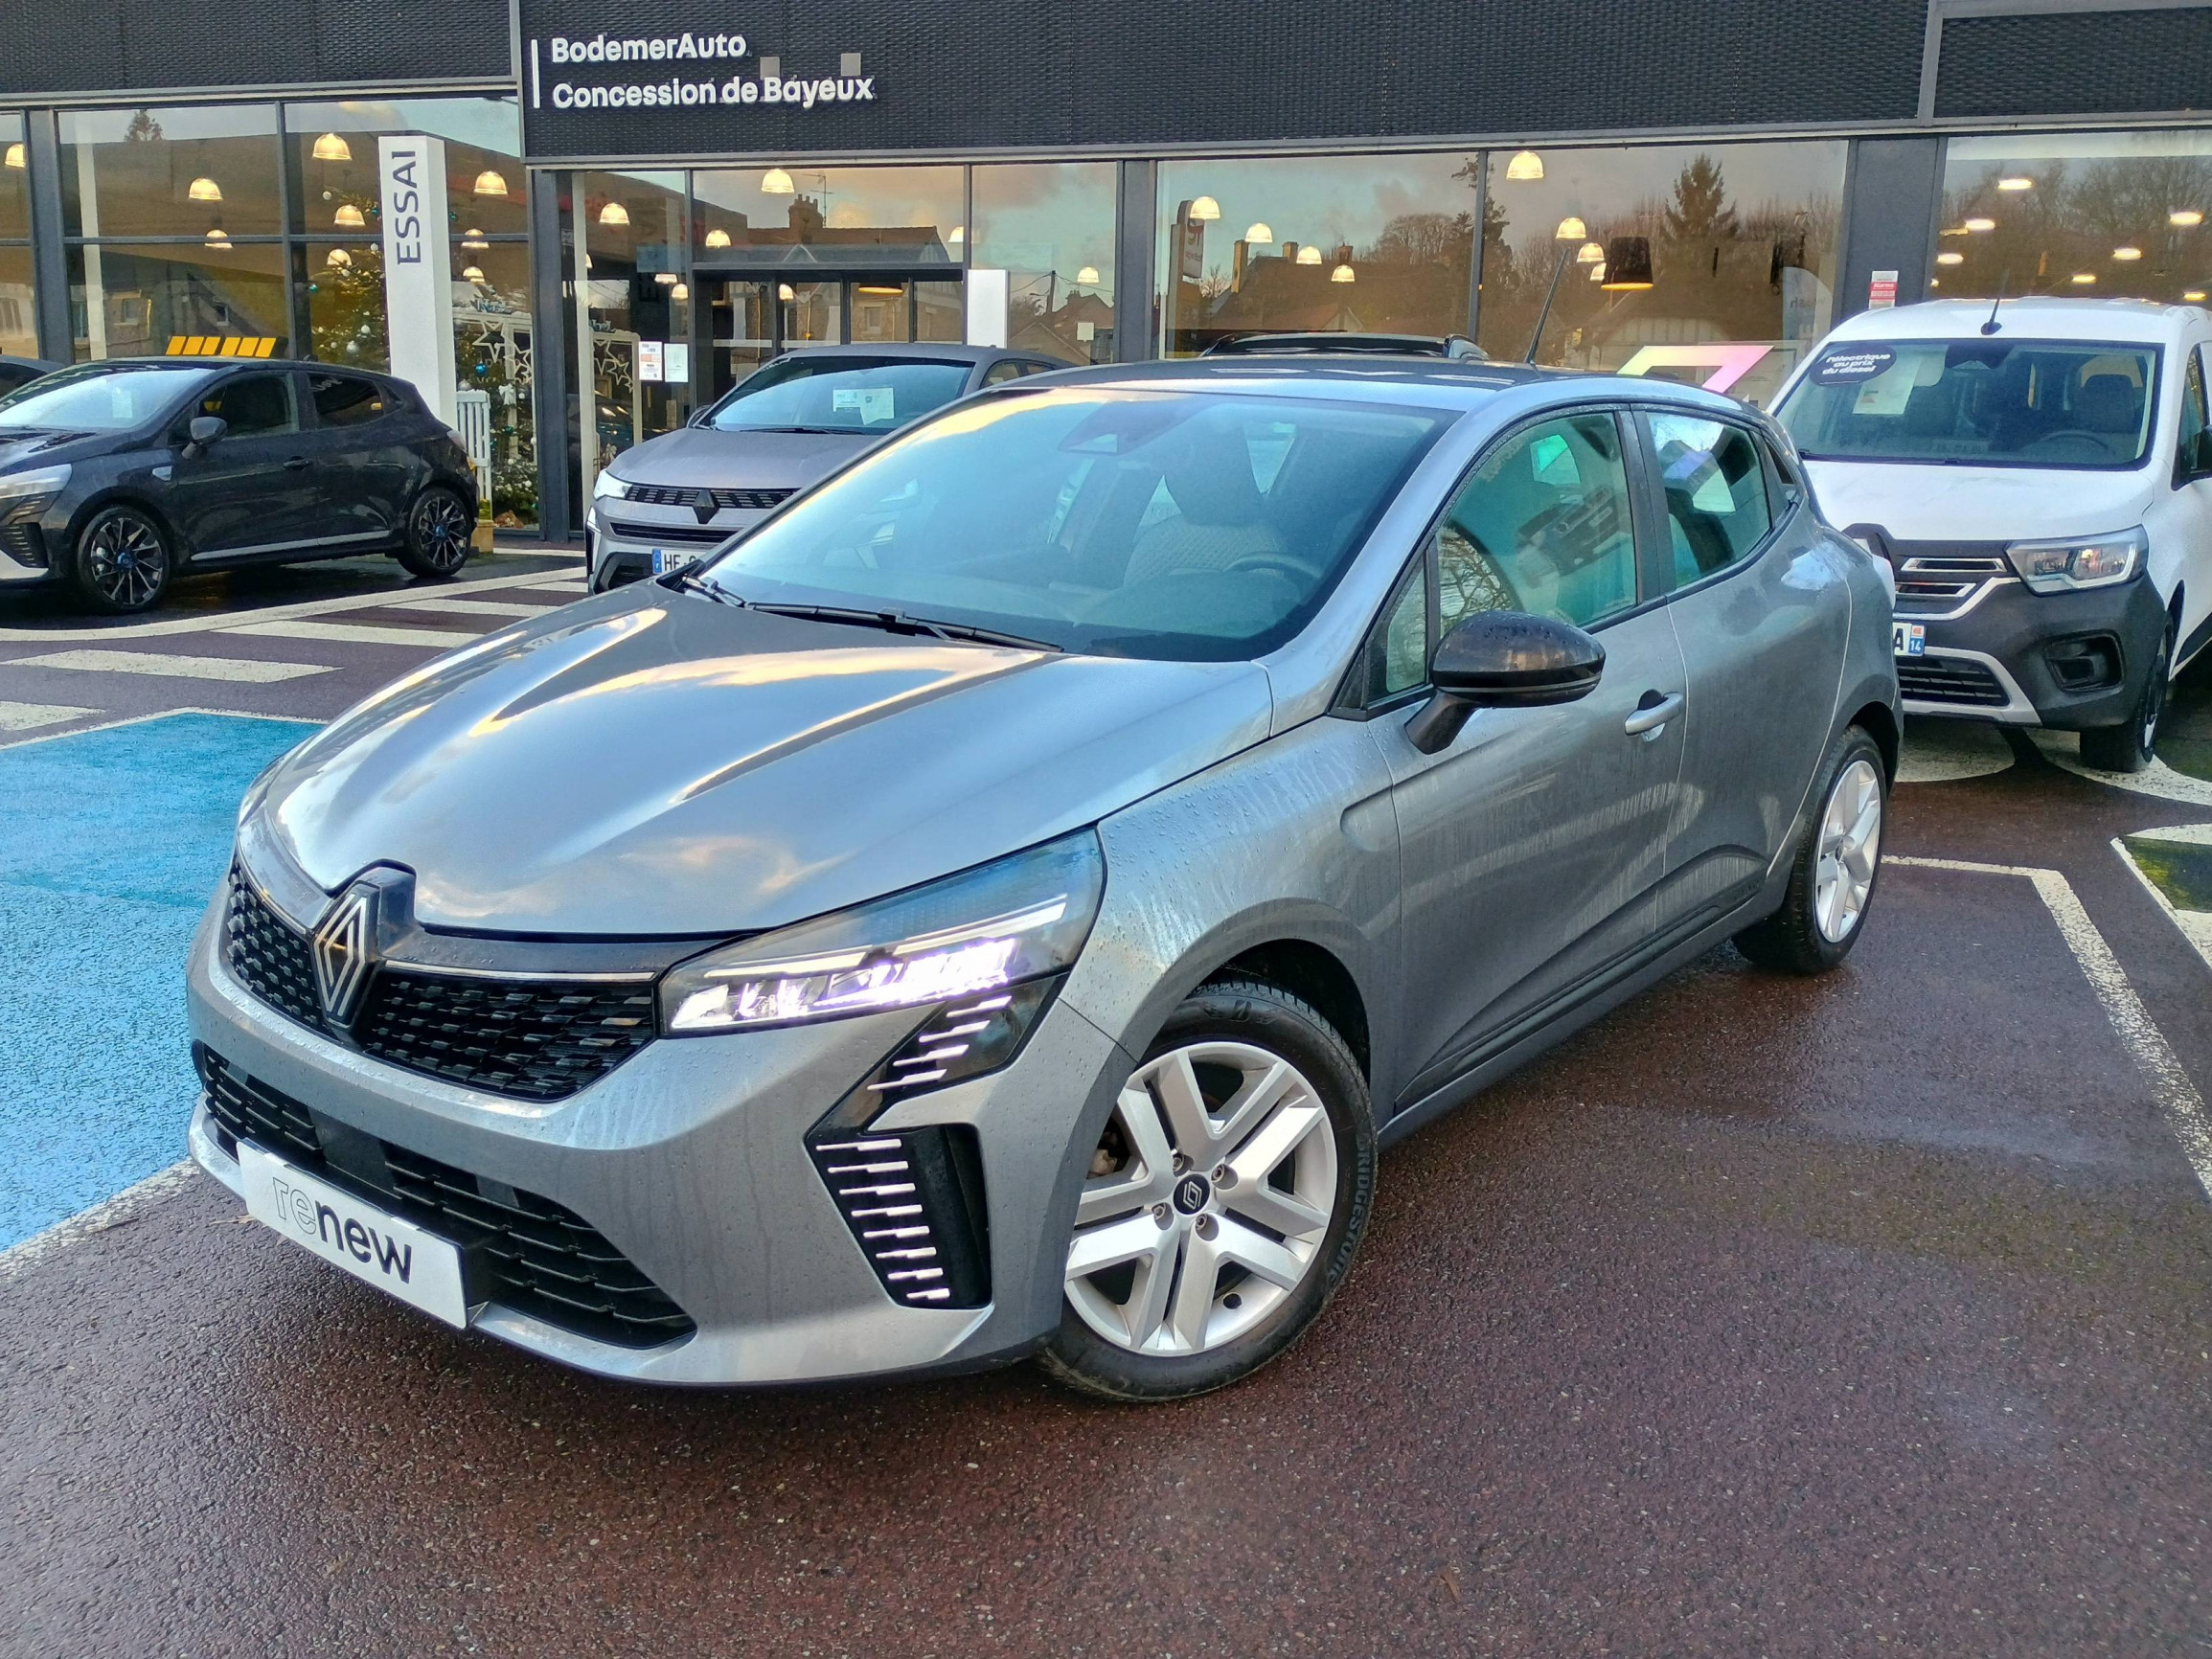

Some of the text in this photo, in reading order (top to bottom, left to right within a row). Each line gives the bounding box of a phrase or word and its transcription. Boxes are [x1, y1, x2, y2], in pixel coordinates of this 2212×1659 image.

[551, 33, 746, 63] BodemerAuto
[553, 76, 875, 109] Concession de Bayeux
[391, 150, 422, 265] ESSAI
[1838, 365, 1878, 374] diesel
[1910, 640, 1922, 651] 14
[272, 1176, 413, 1285] renew
